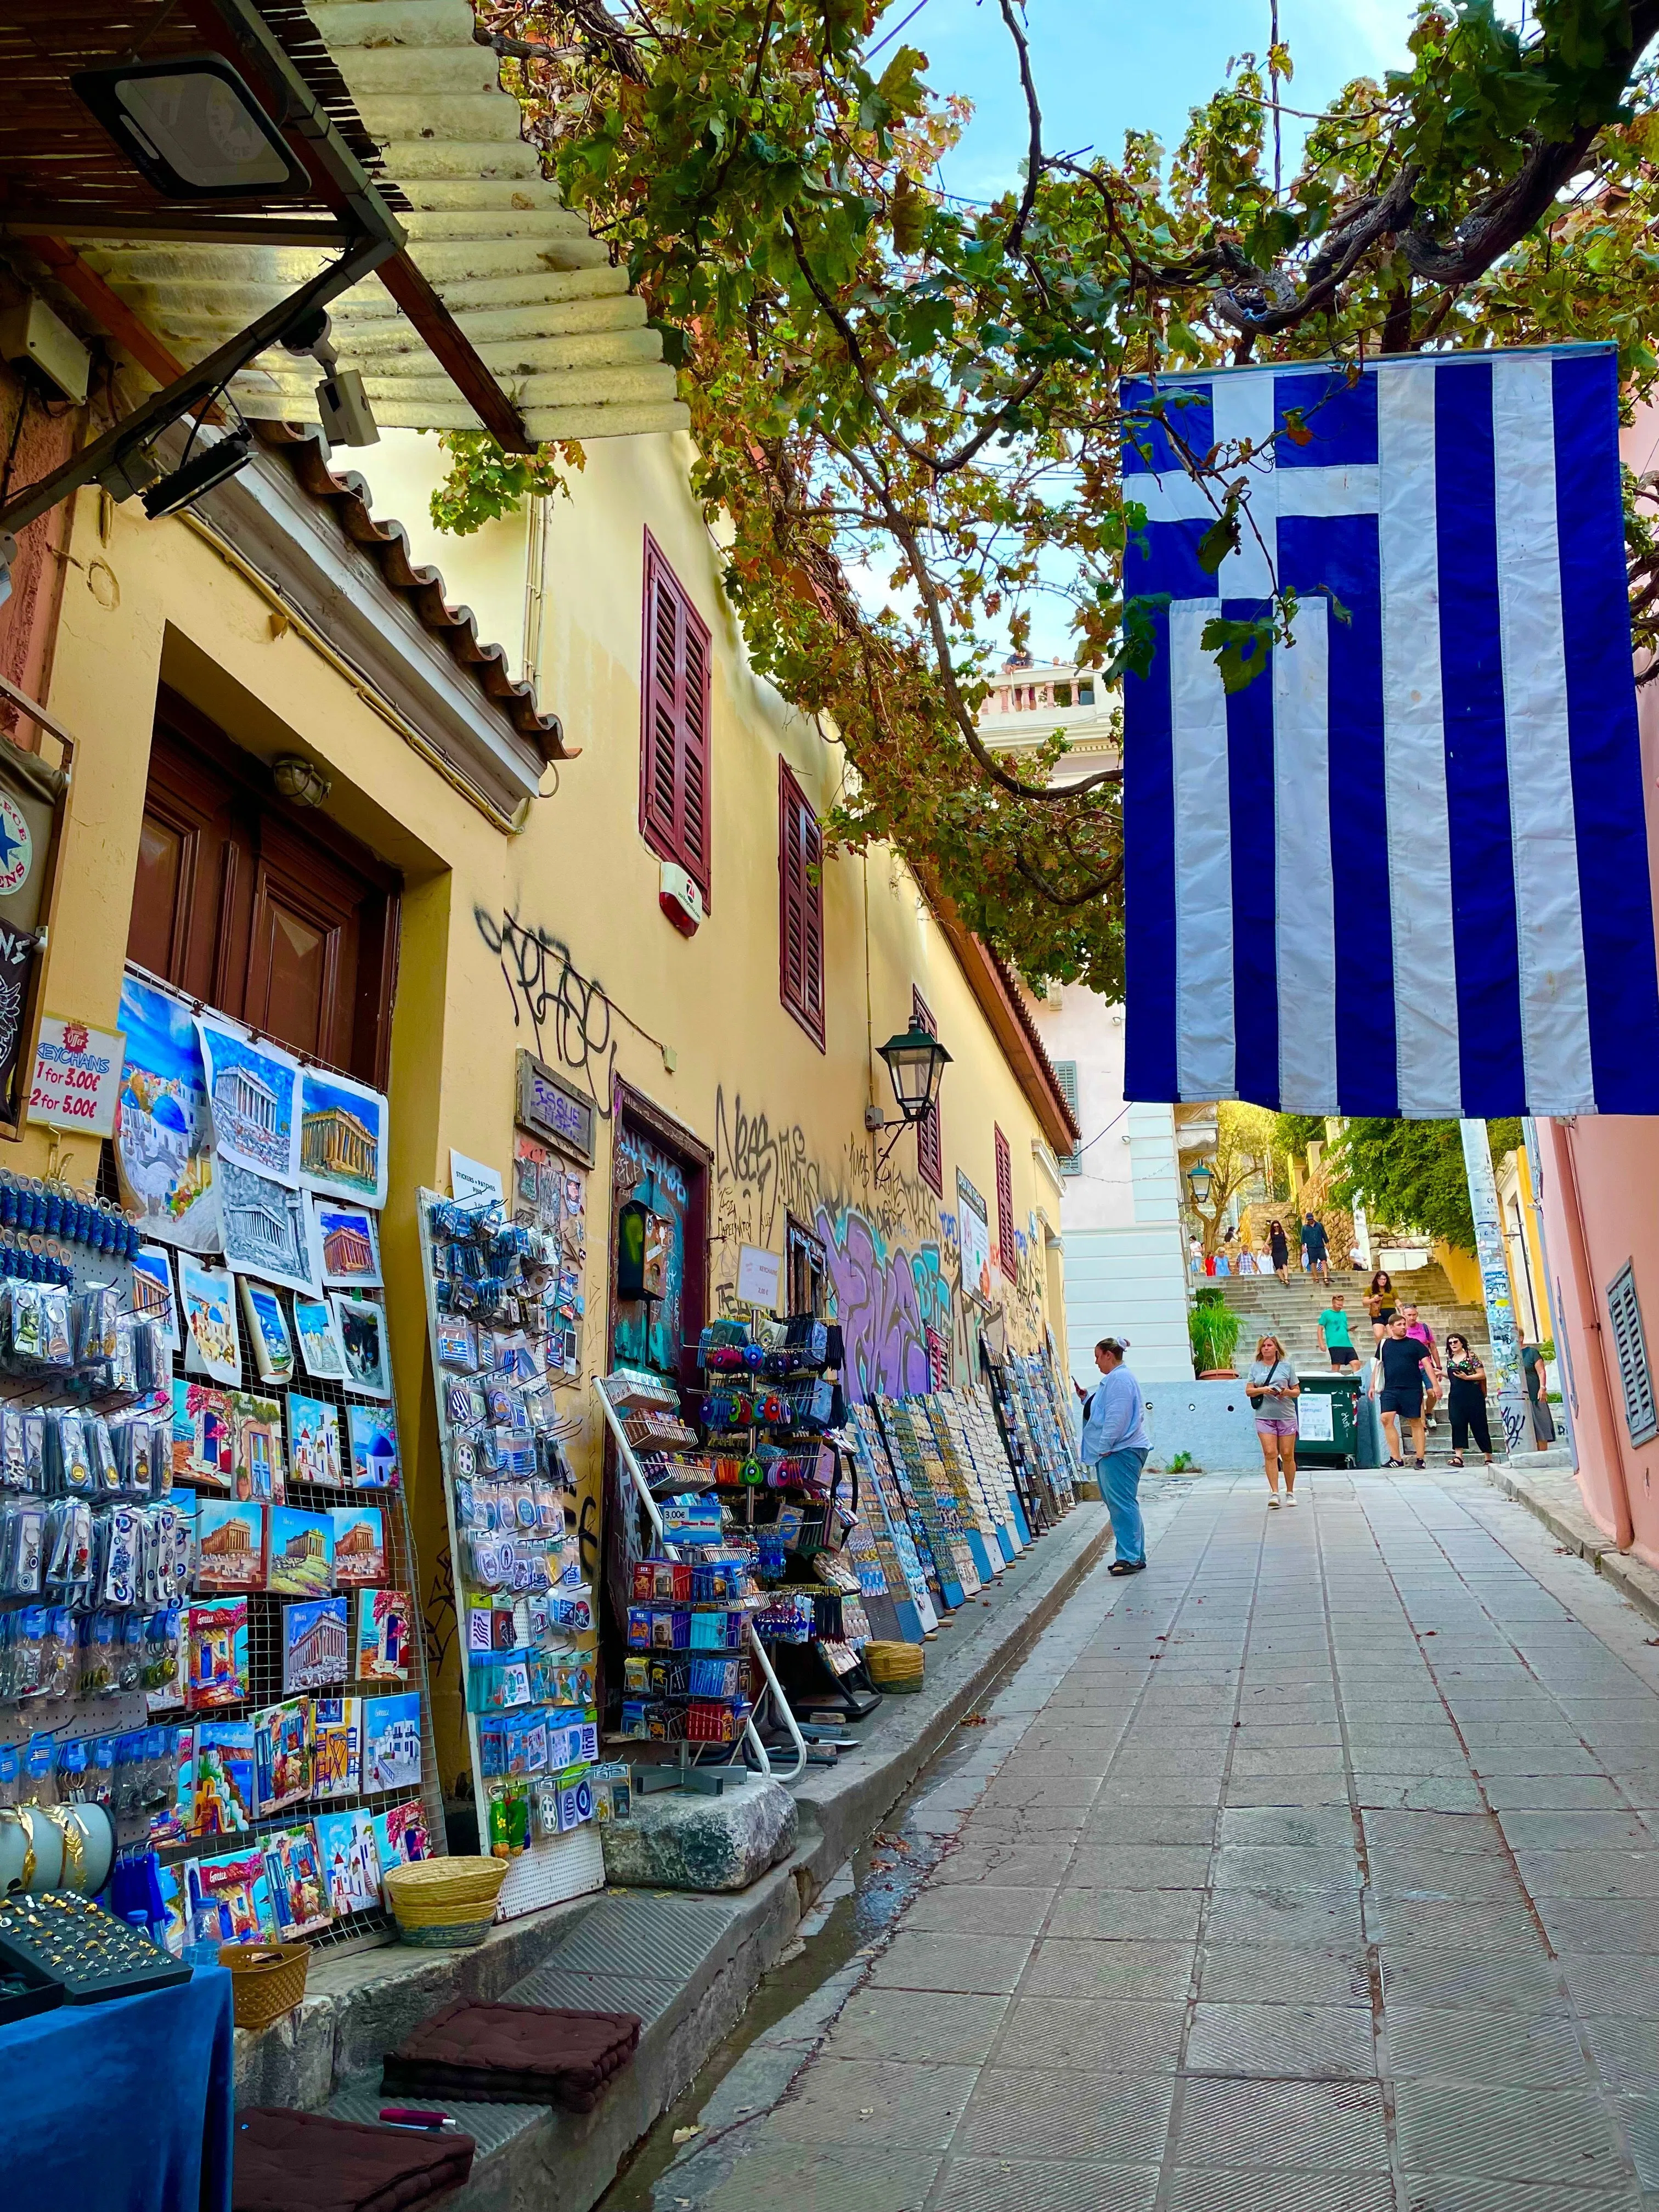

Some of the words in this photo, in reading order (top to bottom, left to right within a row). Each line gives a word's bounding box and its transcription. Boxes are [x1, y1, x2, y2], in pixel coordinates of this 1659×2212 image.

[67, 1032, 86, 1047] Offer
[37, 1061, 45, 1079] 1
[45, 1068, 64, 1084] for
[65, 1068, 101, 1092] 3.00€
[30, 1088, 42, 1106] 2
[41, 1094, 60, 1110] for
[62, 1095, 98, 1119] 5.00€
[456, 1171, 475, 1183] STICKERS
[665, 1510, 685, 1520] 3,00€
[197, 1613, 215, 1625] Greece
[210, 1871, 228, 1883] Greece
